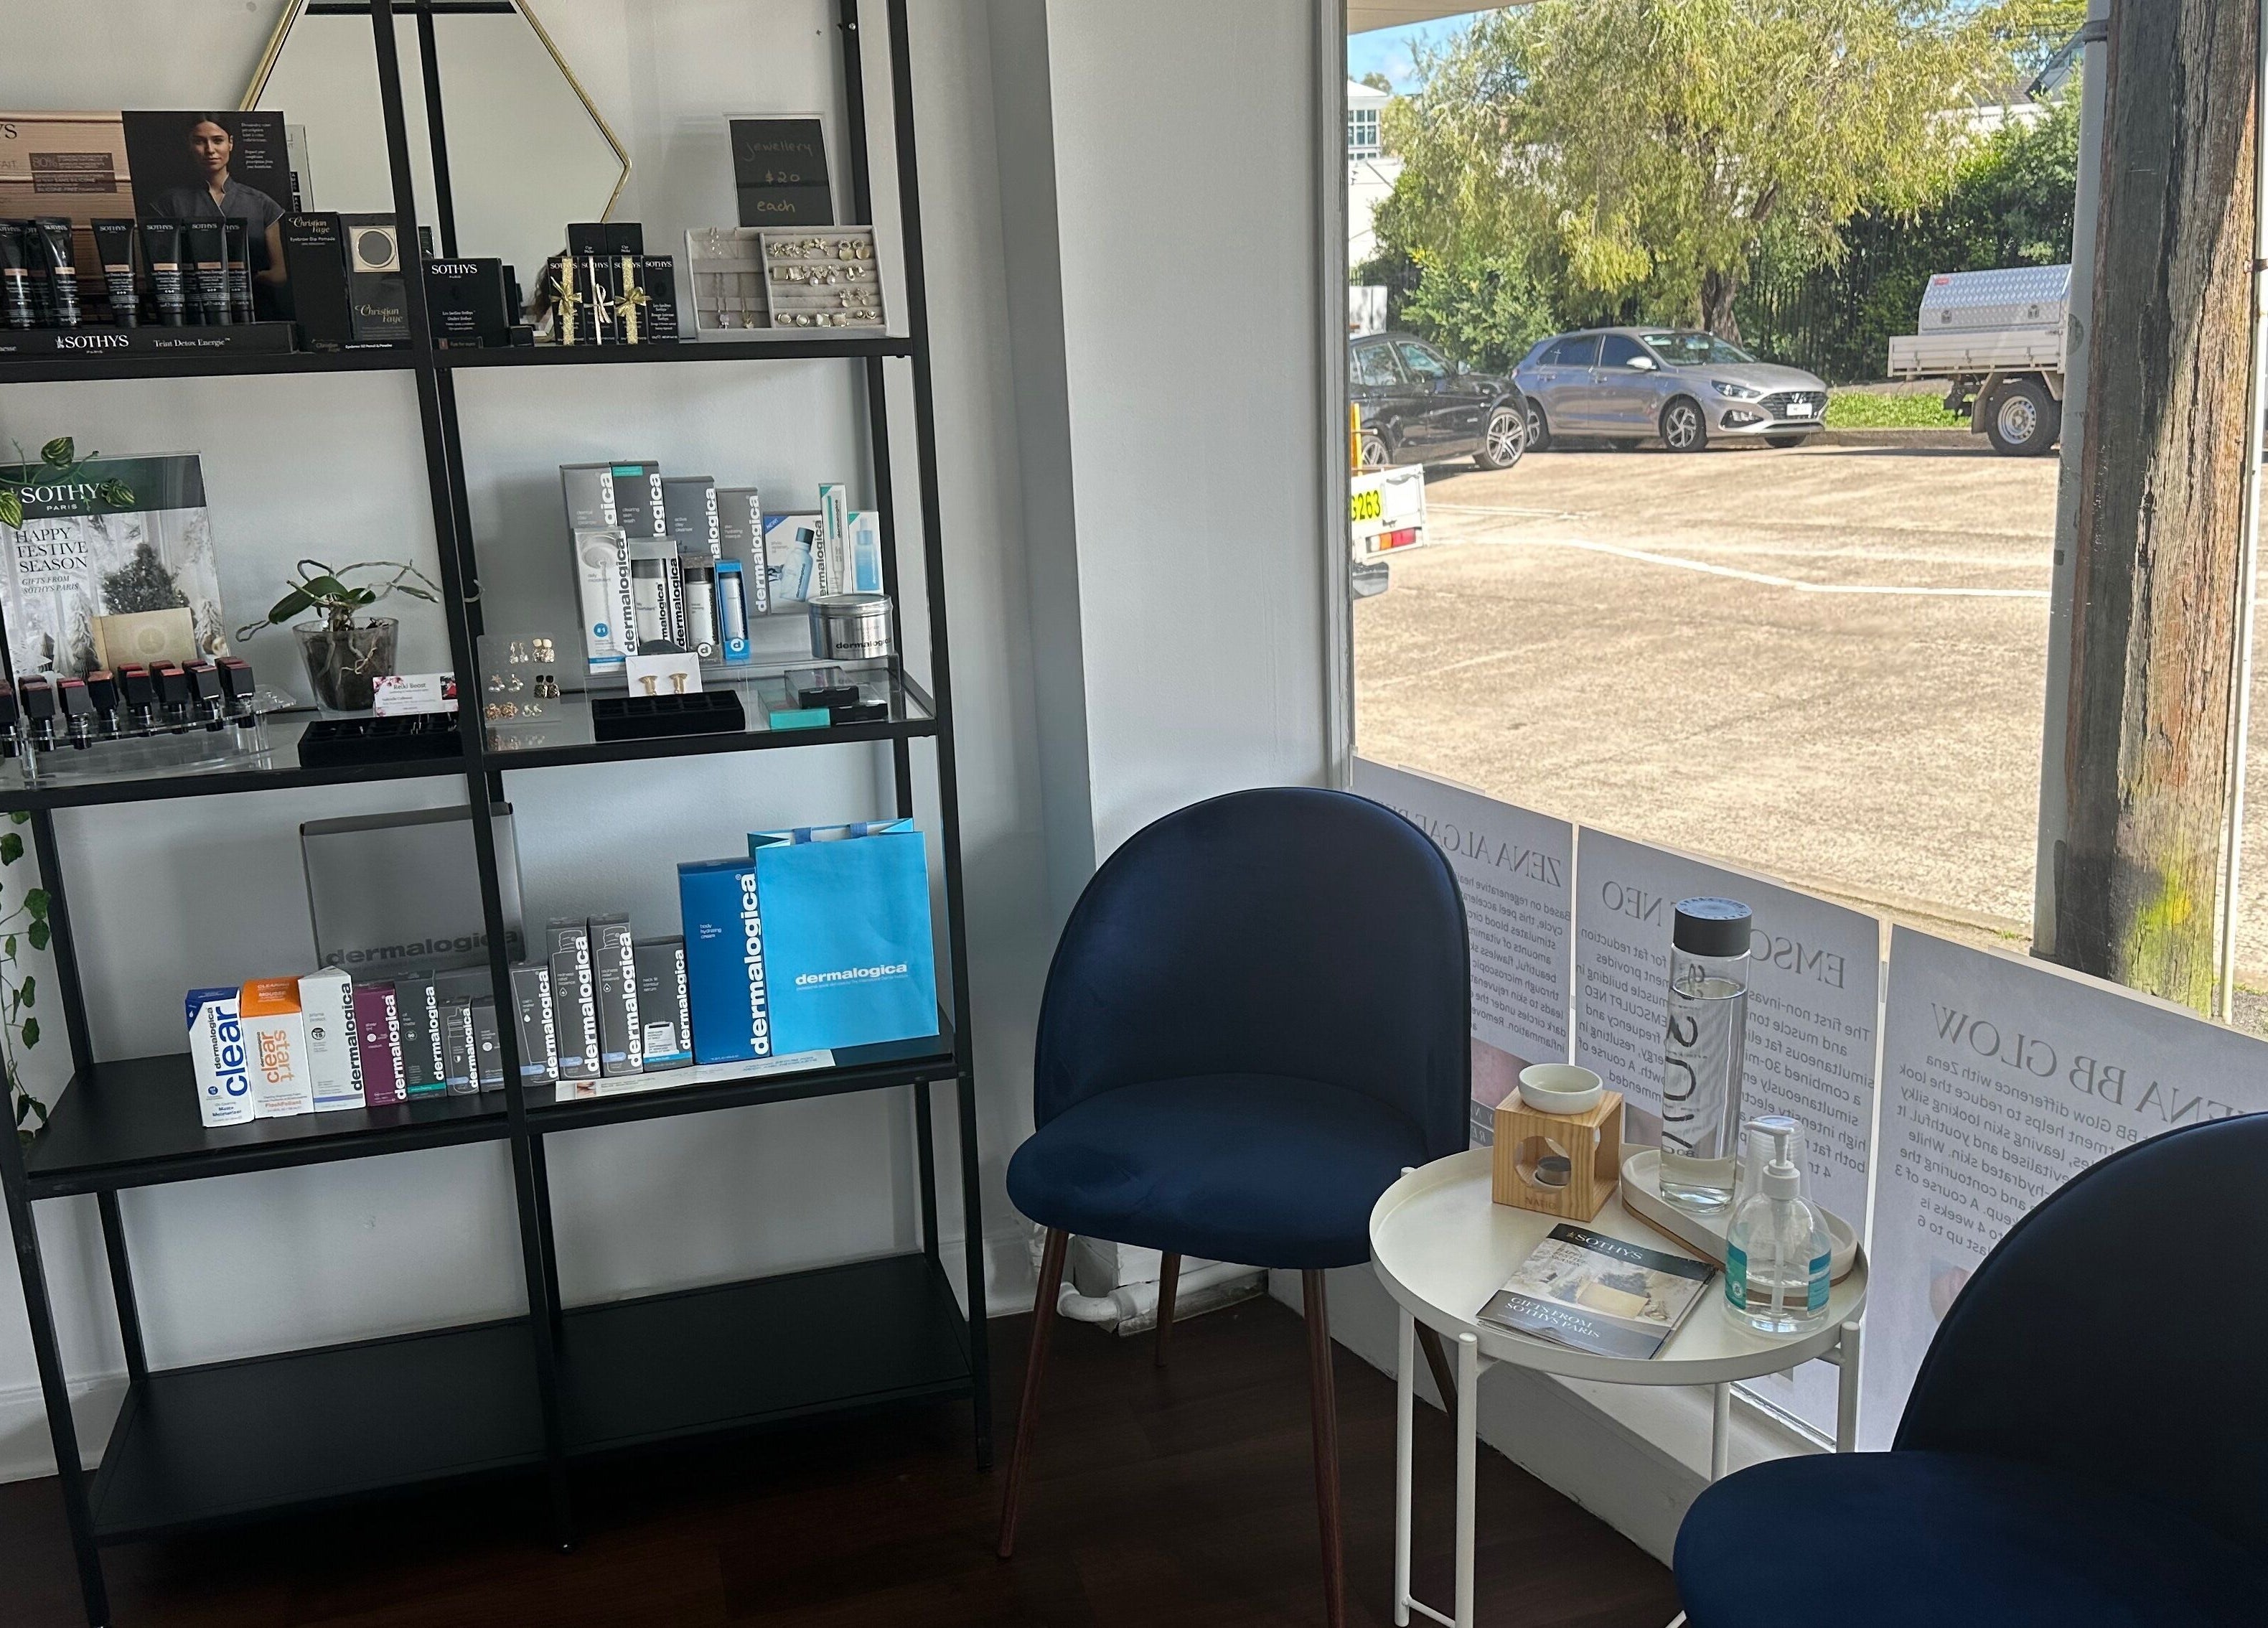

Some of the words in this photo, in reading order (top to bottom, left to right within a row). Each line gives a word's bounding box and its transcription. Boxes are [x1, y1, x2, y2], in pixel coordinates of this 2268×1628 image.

[742, 140, 813, 162] jewellery
[765, 169, 800, 184] $20
[756, 200, 796, 213] each
[431, 263, 478, 274] SOTHYS
[355, 304, 399, 316] Christian
[65, 335, 129, 350] SOTHYS
[21, 483, 108, 504] SOTHY
[650, 473, 667, 537] logica
[14, 527, 72, 543] HAPPY
[17, 541, 89, 558] FESTIVE
[706, 487, 721, 559] alogica
[19, 556, 88, 574] SEASON
[22, 577, 47, 586] GIFTS
[47, 575, 70, 584] FROM
[749, 495, 767, 612] dermalogica
[814, 520, 827, 597] ermalogica
[615, 537, 635, 652] dermalogica
[657, 583, 669, 640] malogica
[670, 557, 686, 647] dermalogica
[740, 873, 769, 1055] dermalogica
[795, 963, 907, 986] dermalogica
[538, 969, 559, 1078] dermalogica
[575, 935, 599, 1072] dermalogica
[619, 932, 642, 1067] dermalogica
[675, 948, 691, 1050] dermalogica
[207, 1007, 222, 1070] dermalogica
[215, 1006, 248, 1097] clear
[261, 1031, 281, 1084] clear
[274, 1029, 295, 1082] start
[341, 983, 363, 1091] dermalogica
[385, 994, 407, 1100] dermalogica
[425, 986, 445, 1081] dermalogica
[461, 1007, 479, 1088] dermalogica
[1574, 1233, 1644, 1260] SOTHYS
[1505, 1302, 1560, 1326] SOTHYS
[1510, 1296, 1550, 1315] GIFTS
[1551, 1309, 1594, 1329] FROM
